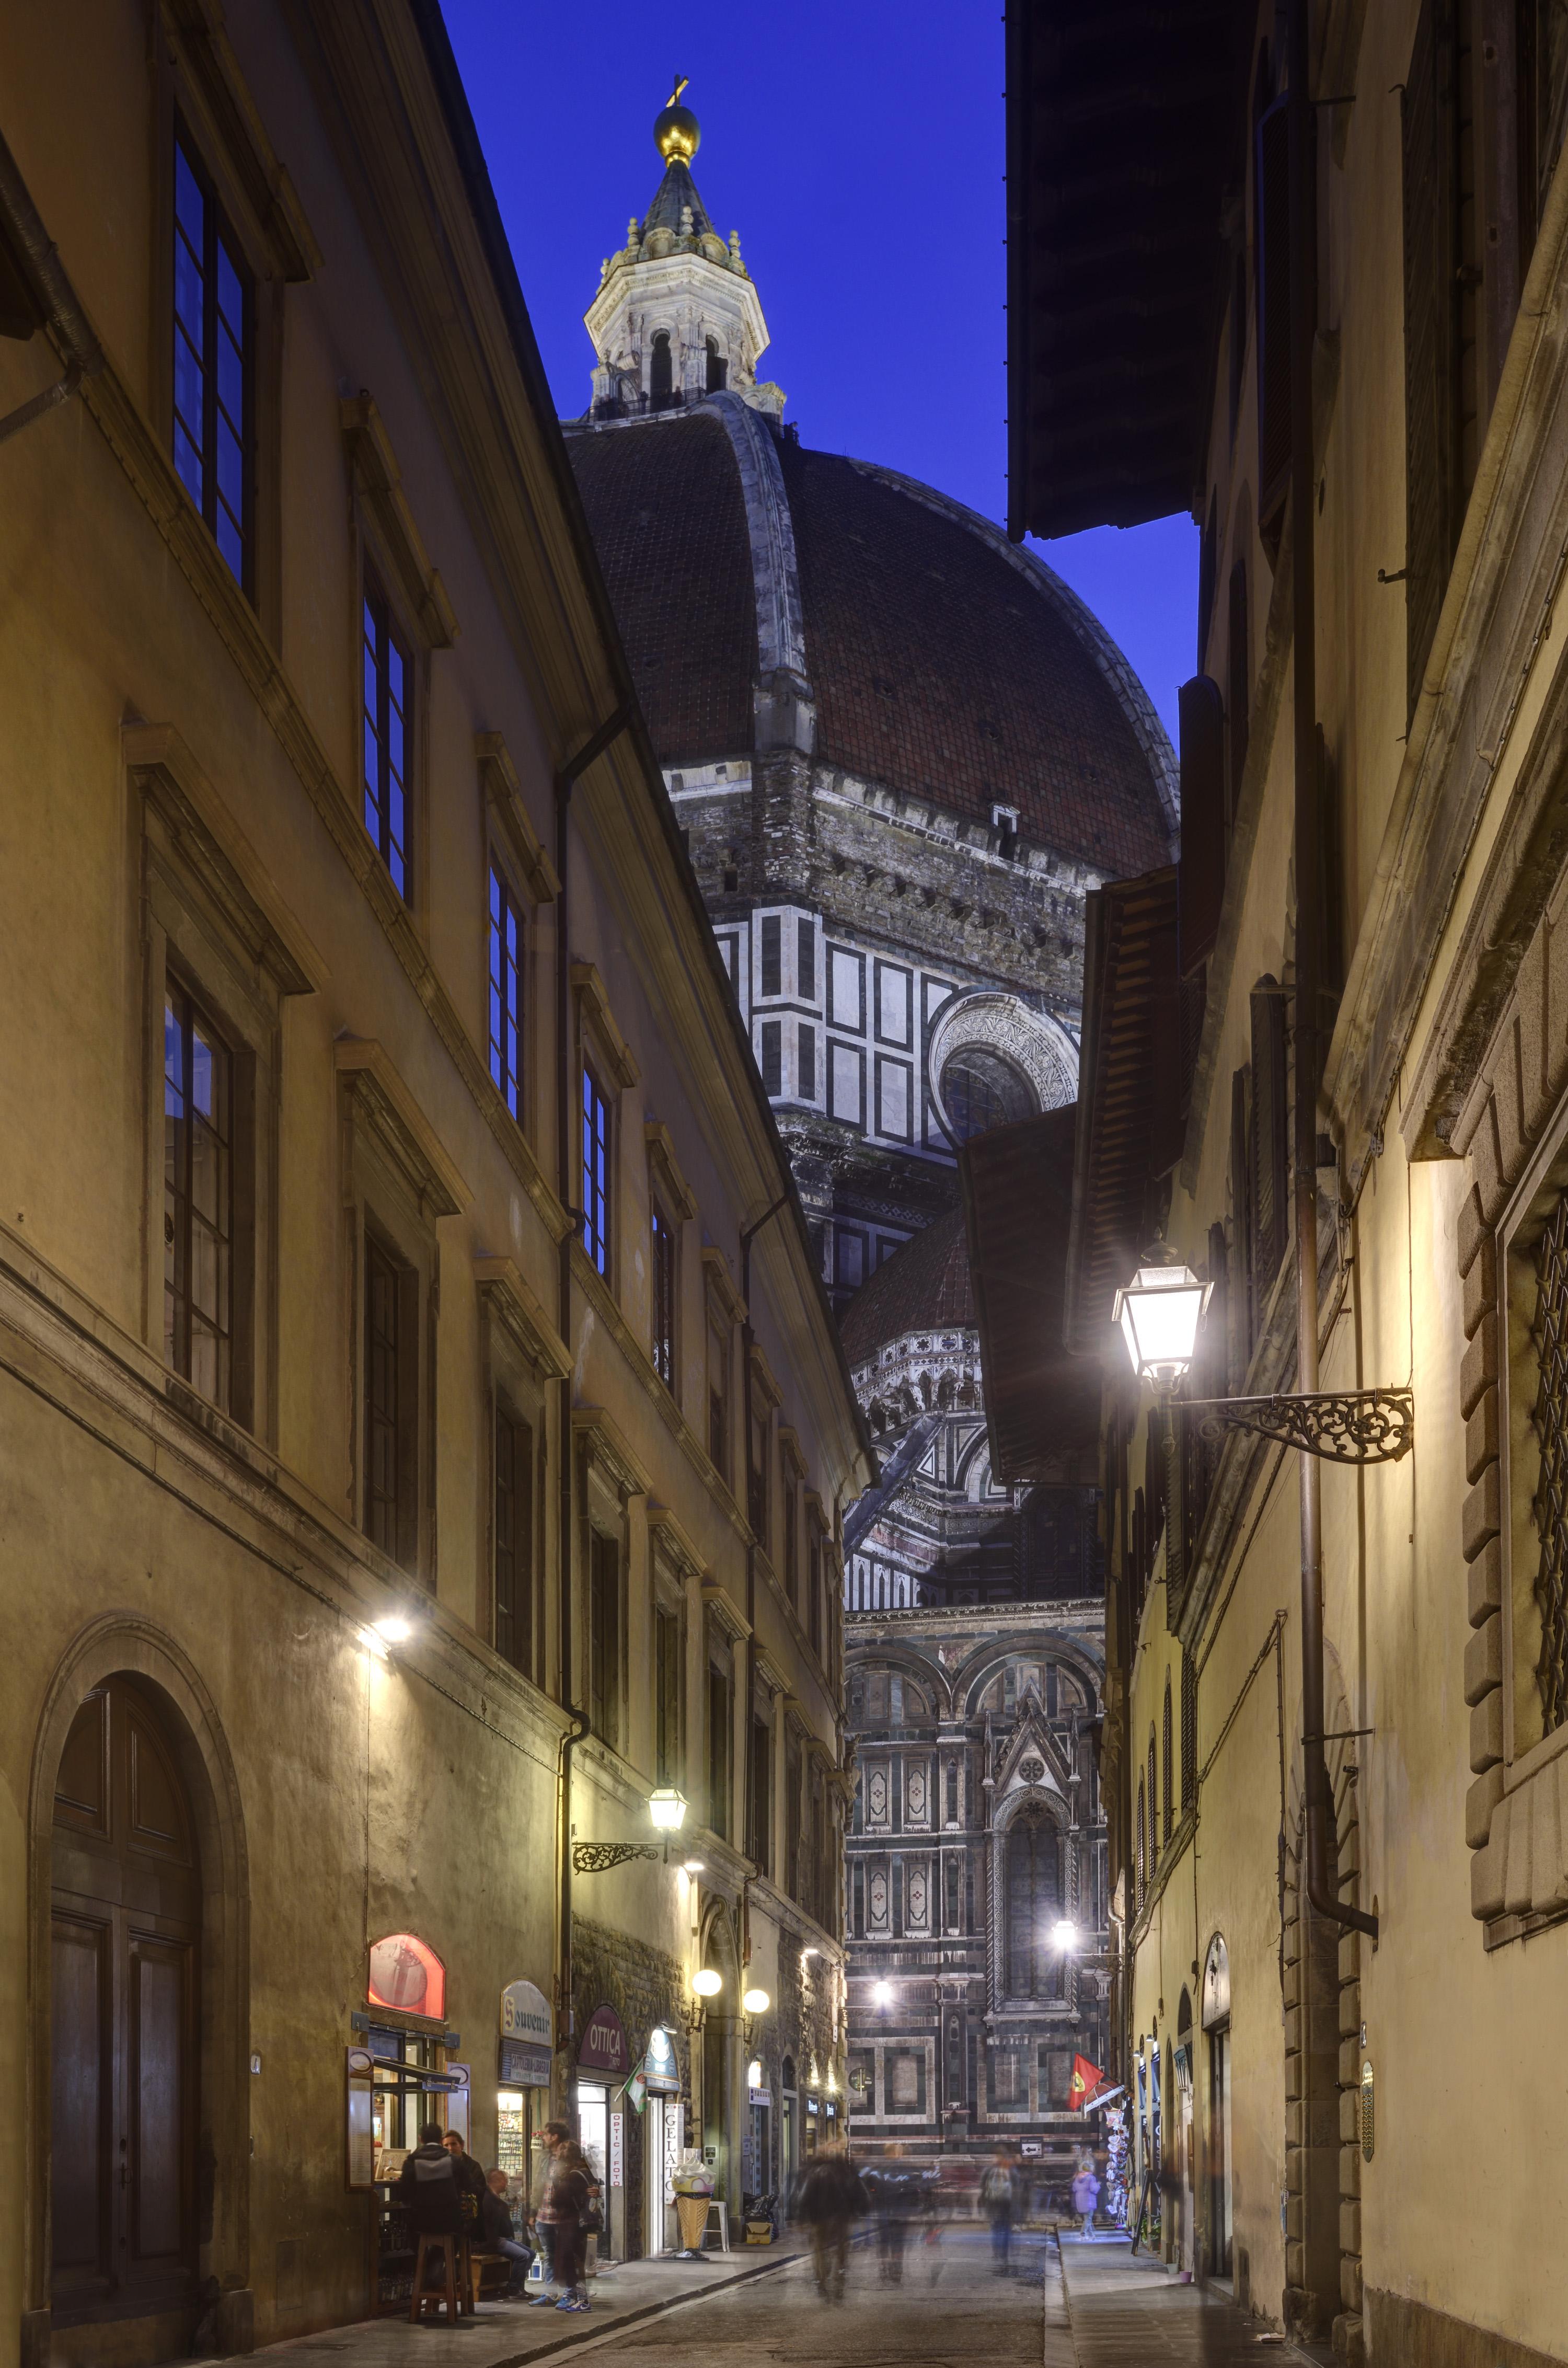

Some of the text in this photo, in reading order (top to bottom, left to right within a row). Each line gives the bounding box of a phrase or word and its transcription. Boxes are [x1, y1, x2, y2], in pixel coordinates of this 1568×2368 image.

[505, 1999, 550, 2034] Souvenir
[590, 2024, 620, 2055] OTTICA
[665, 2114, 677, 2192] GELATO
